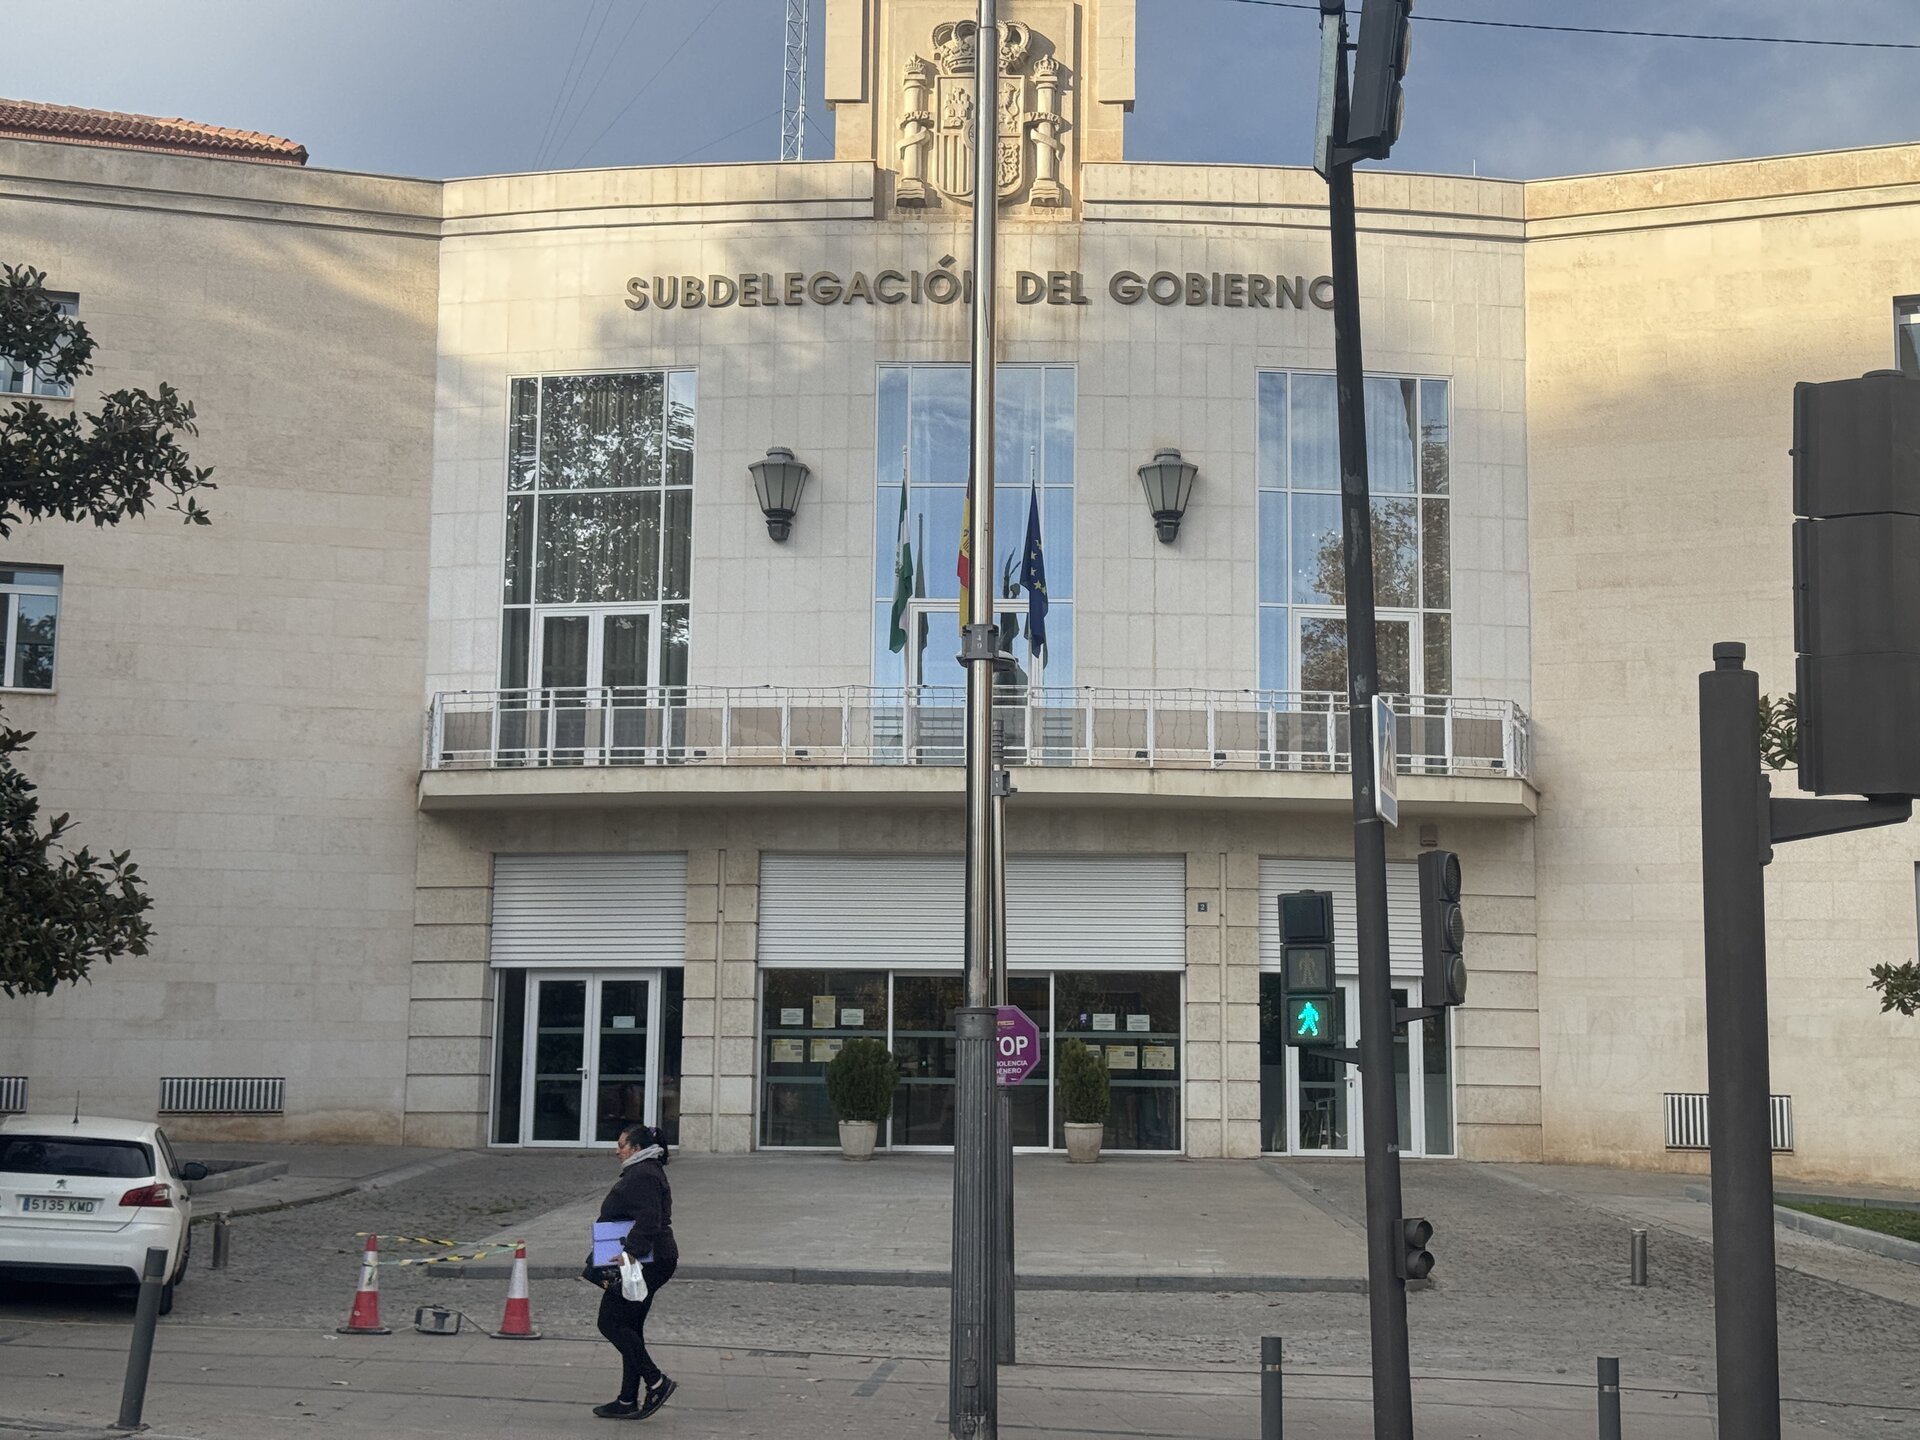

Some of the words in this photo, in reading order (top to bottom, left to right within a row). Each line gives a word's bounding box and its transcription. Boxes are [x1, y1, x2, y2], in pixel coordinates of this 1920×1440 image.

[1015, 270, 1092, 306] DEL
[1108, 270, 1335, 310] GOBIERNO
[996, 1036, 1028, 1056] OP
[996, 1067, 1022, 1075] ÉNERO
[31, 1198, 65, 1211] 5135
[68, 1200, 94, 1213] KMD
